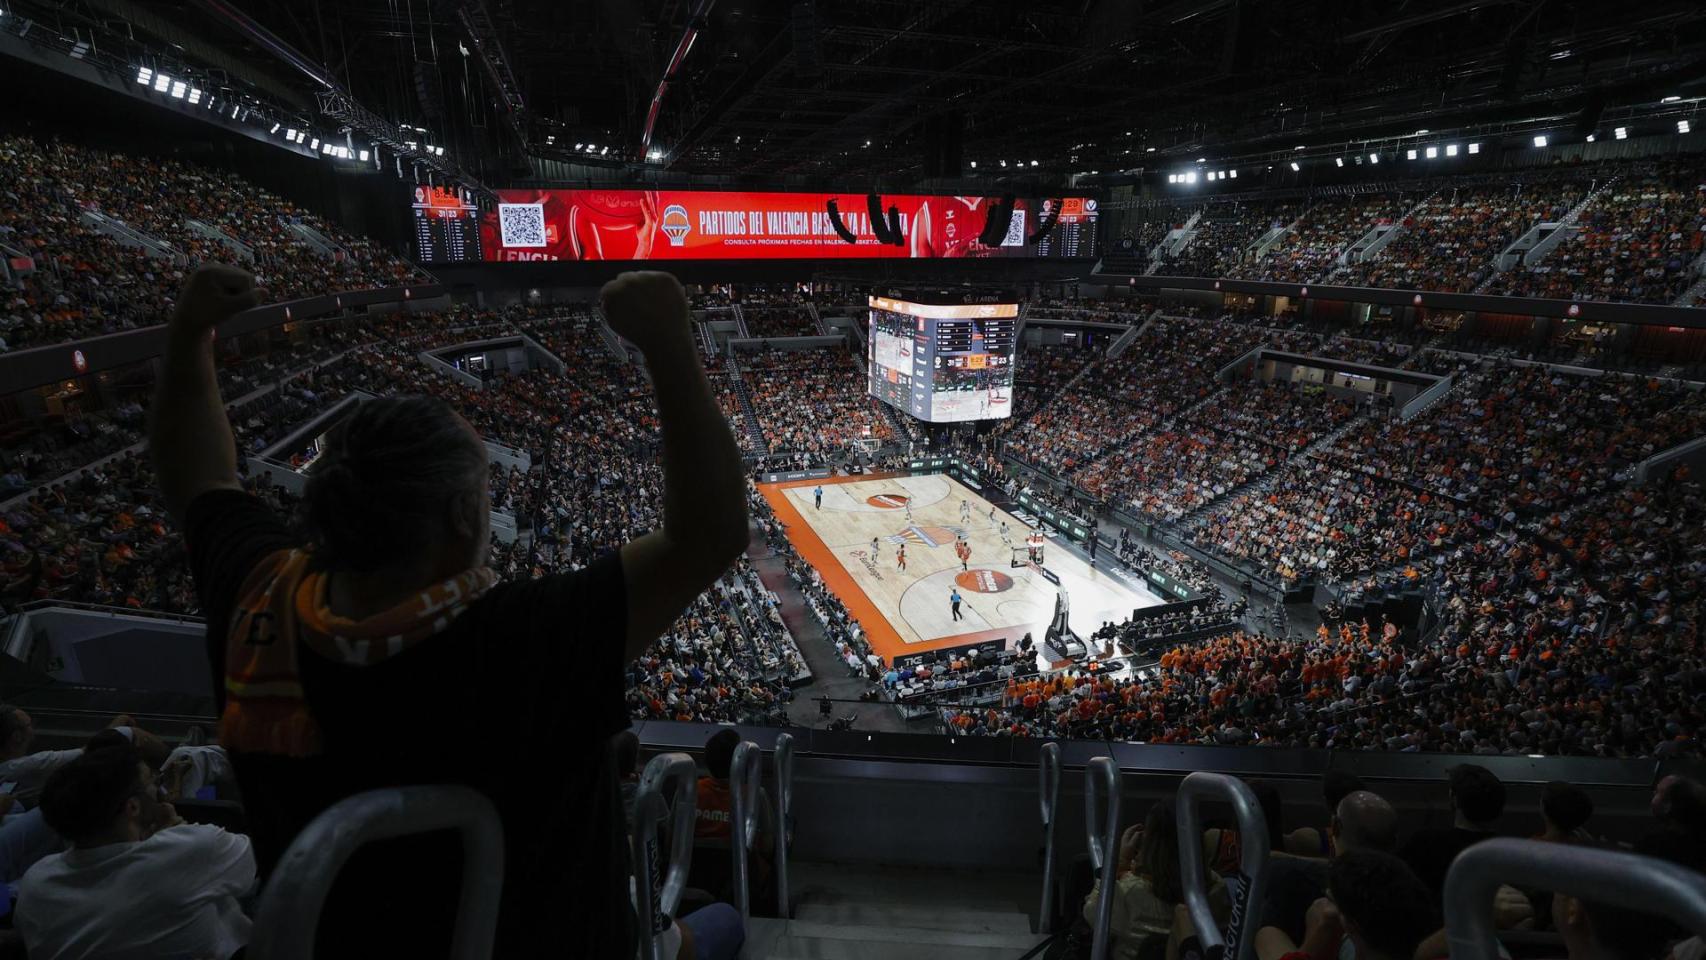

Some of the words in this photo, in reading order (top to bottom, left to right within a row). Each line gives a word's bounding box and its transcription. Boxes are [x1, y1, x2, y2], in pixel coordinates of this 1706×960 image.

[699, 211, 746, 235] PARTIDOS
[749, 211, 764, 235] DEL
[767, 212, 809, 235] VALENCIA
[848, 212, 858, 235] VA
[861, 212, 867, 235] A
